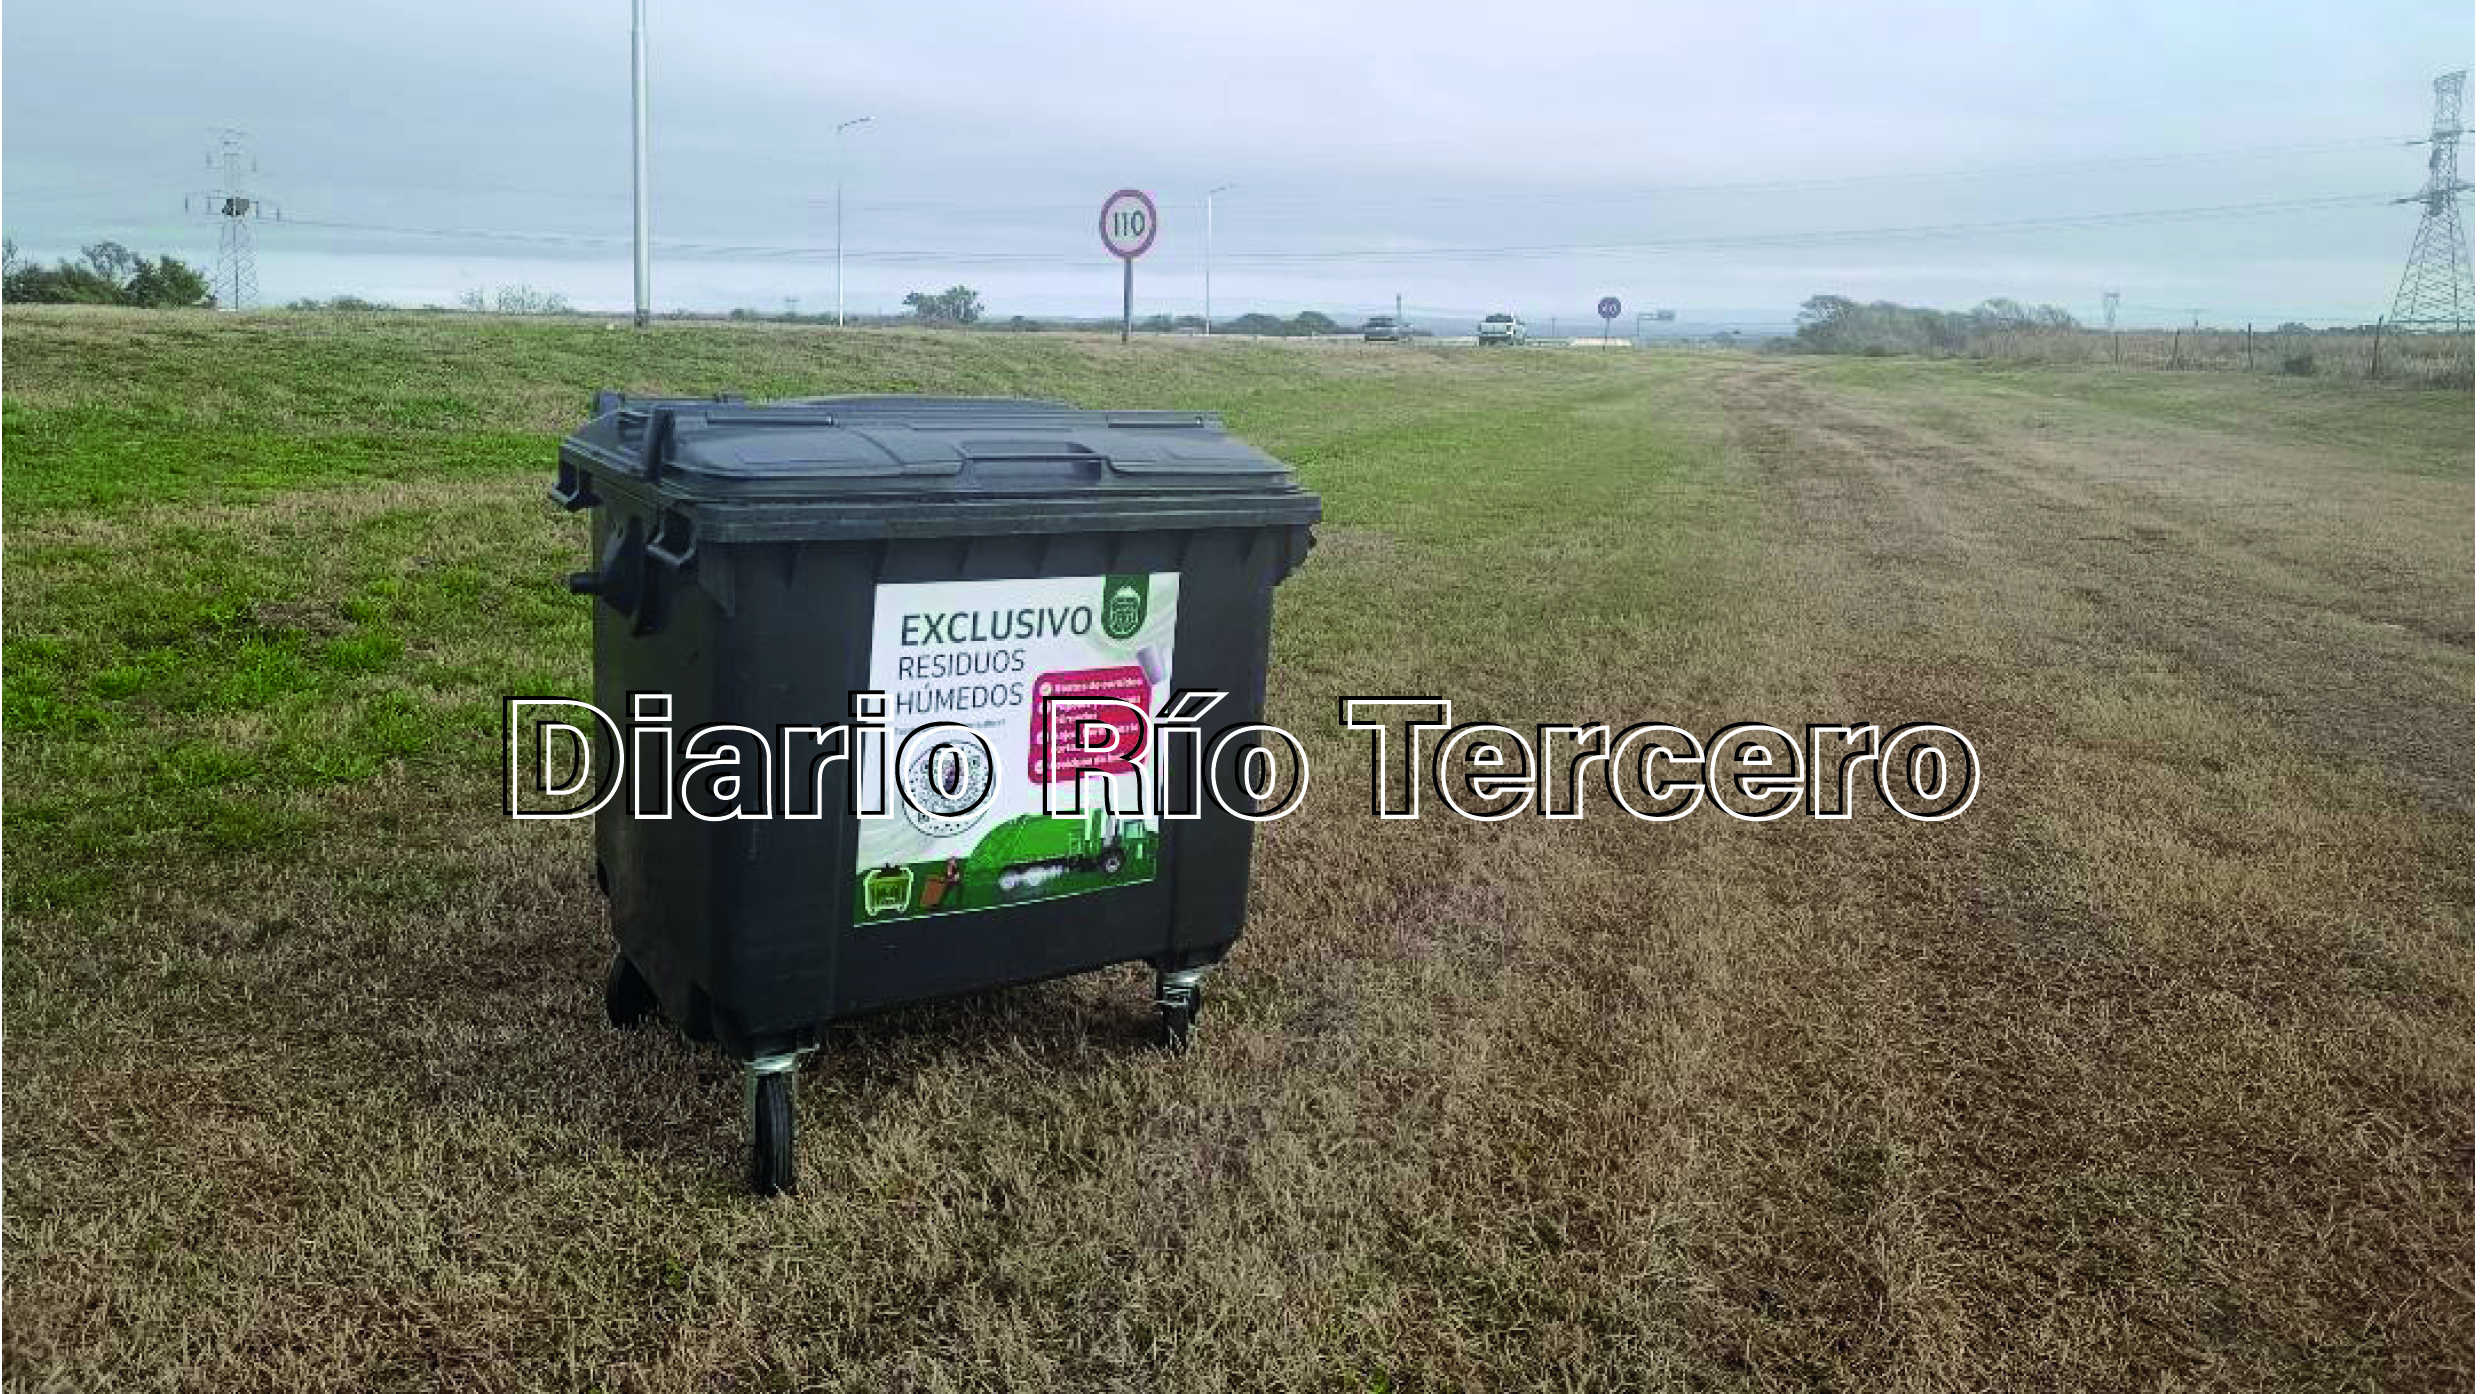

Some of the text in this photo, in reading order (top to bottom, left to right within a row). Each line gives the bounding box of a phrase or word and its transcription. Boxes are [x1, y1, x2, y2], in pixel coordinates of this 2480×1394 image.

[1114, 210, 1145, 236] 110
[901, 606, 1092, 646] EXCLUSIVO
[899, 649, 1026, 680] RESIDUOS
[896, 682, 1023, 714] HÚMEDOS
